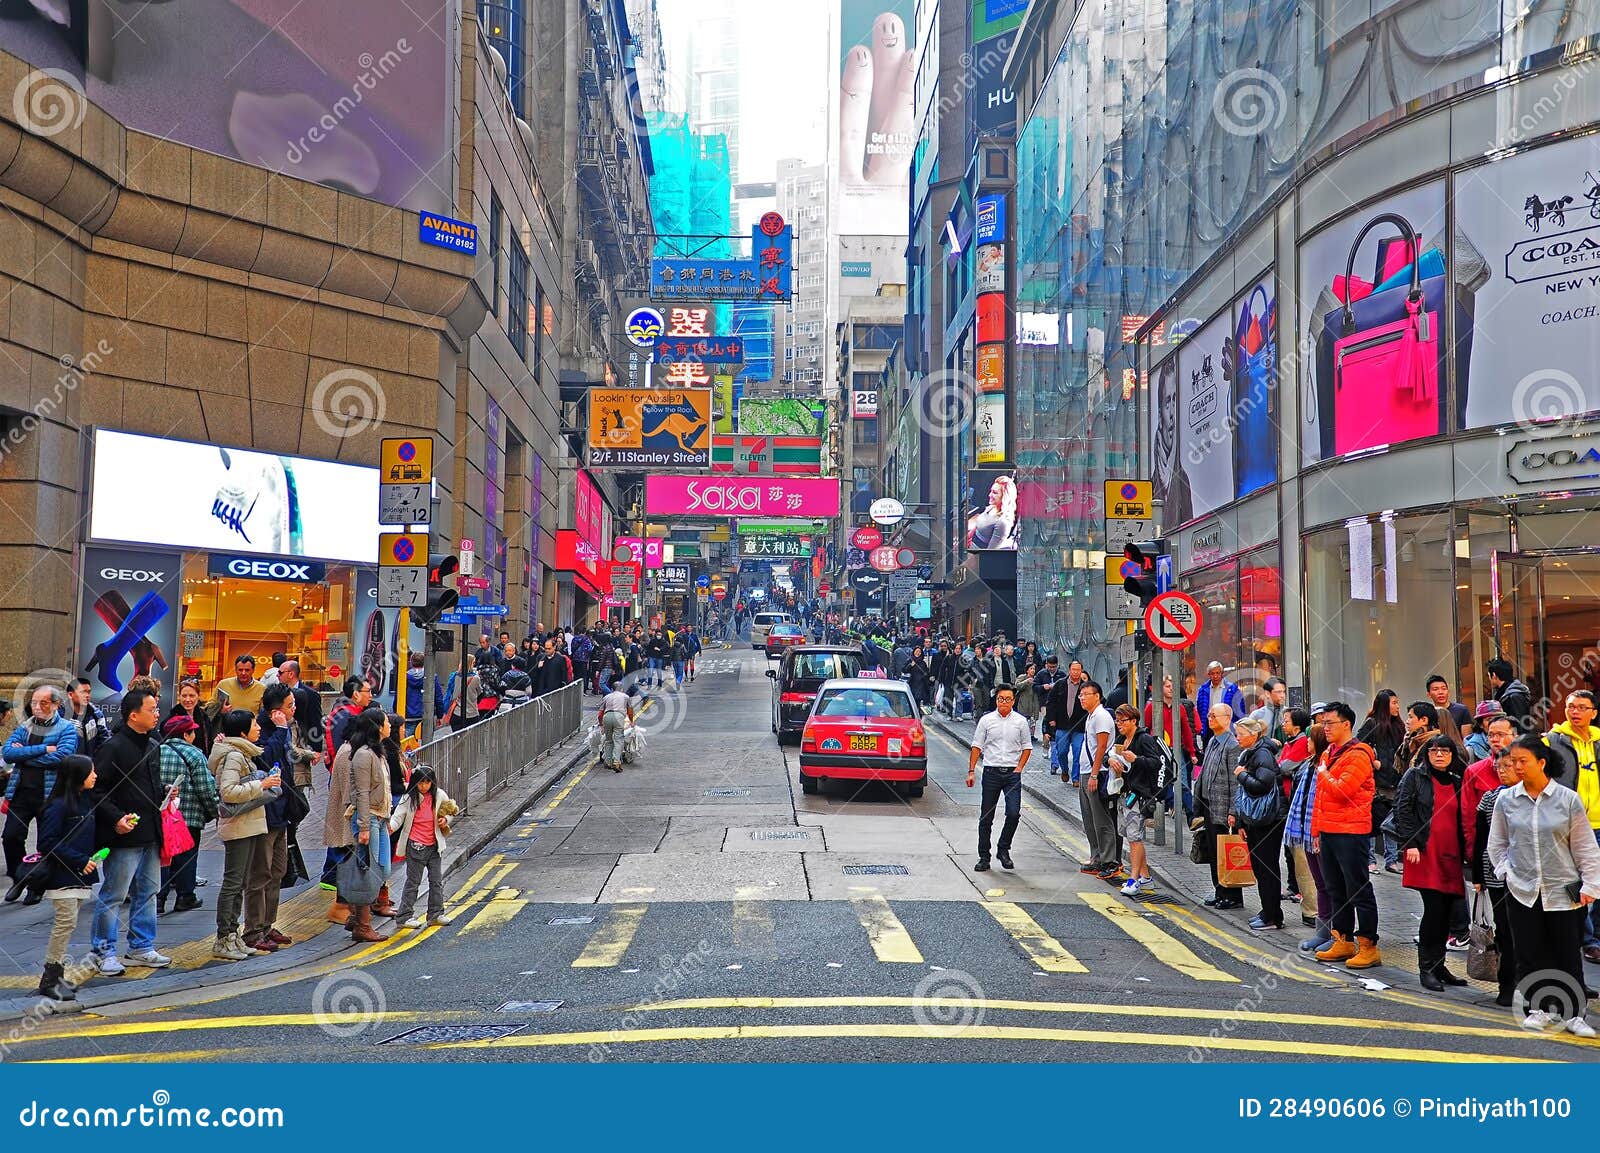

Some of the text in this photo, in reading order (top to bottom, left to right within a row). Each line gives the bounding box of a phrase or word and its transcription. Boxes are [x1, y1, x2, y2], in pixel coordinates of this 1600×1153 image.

[423, 216, 475, 240] AVANTI
[435, 232, 454, 244] 2117
[1563, 253, 1588, 265] EST.
[1545, 274, 1600, 294] NEW Y
[631, 394, 643, 403] for
[856, 393, 877, 404] 28
[592, 451, 614, 464] 2/F.
[673, 452, 706, 463] Street
[413, 487, 421, 500] 7
[412, 508, 427, 521] 12
[1136, 522, 1144, 533] 7
[744, 541, 800, 555] 意大利站
[100, 567, 164, 583] GEOX
[228, 559, 310, 580] GEOX
[410, 570, 419, 583] 7
[410, 590, 418, 604] 7
[851, 742, 876, 750] 3652
